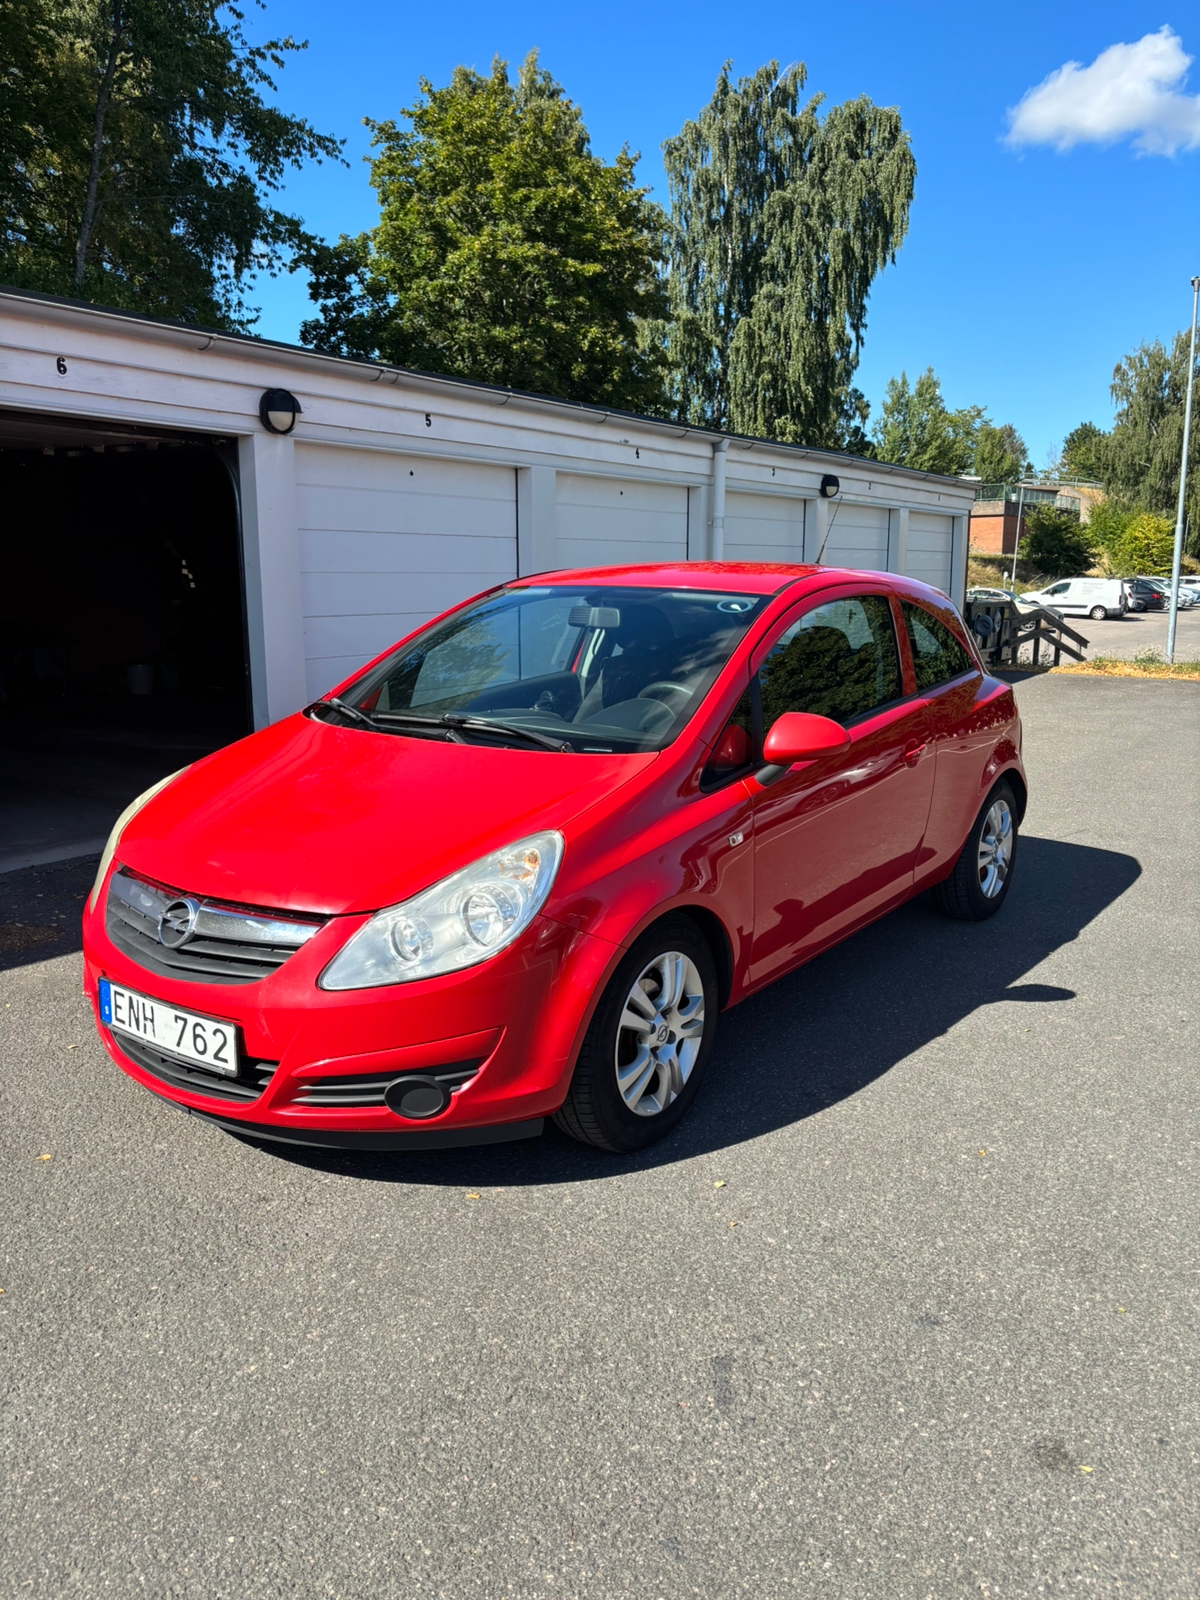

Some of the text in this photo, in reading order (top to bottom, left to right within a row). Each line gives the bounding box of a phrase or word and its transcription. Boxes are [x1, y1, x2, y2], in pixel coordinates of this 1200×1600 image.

[56, 356, 68, 375] 6
[425, 413, 432, 428] 5
[113, 989, 229, 1064] ENH 762
